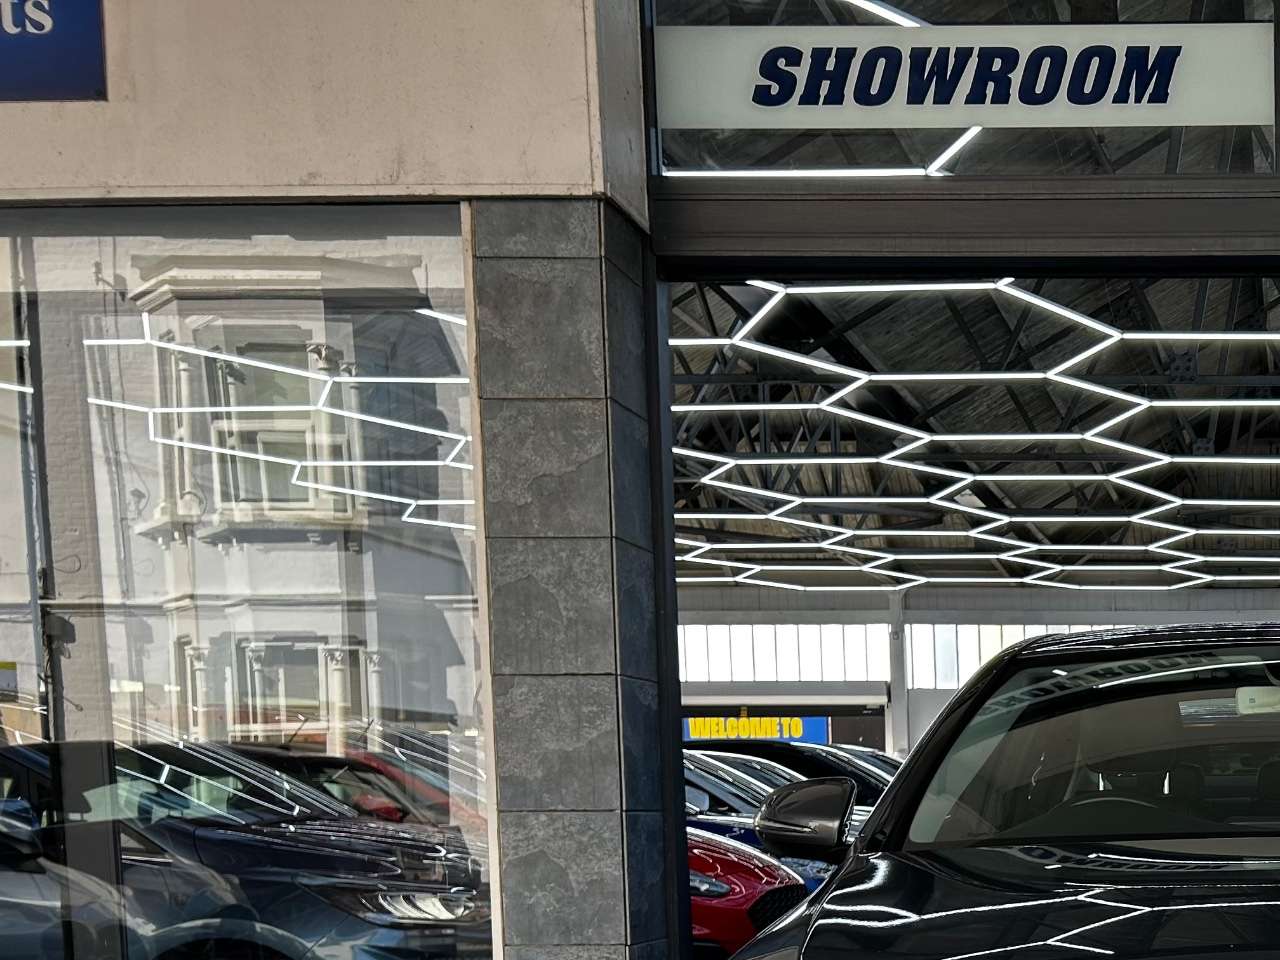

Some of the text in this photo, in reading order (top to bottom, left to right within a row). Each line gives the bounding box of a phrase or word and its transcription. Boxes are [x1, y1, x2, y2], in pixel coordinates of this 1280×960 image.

[0, 0, 54, 34] ts
[751, 44, 1183, 107] SHOWROOM
[688, 717, 803, 739] WELCOME TO
